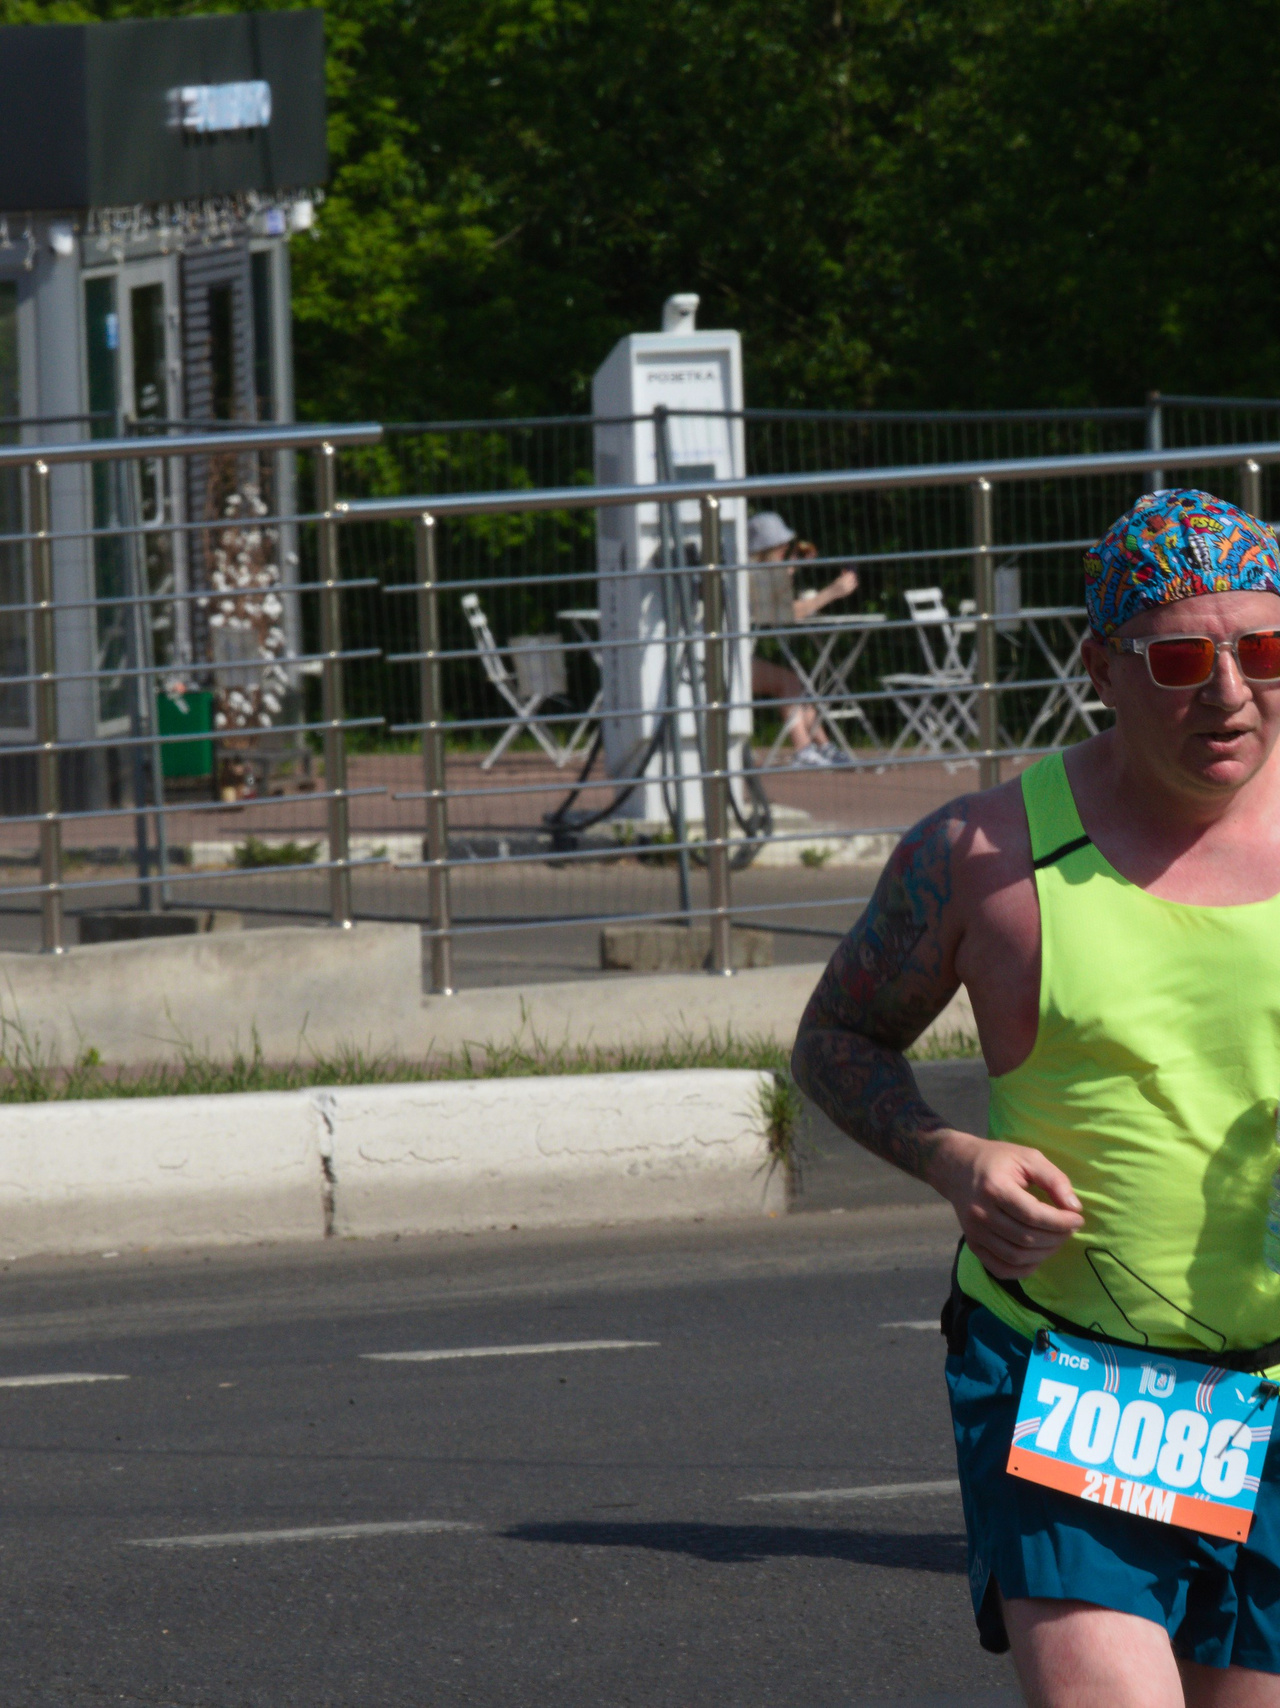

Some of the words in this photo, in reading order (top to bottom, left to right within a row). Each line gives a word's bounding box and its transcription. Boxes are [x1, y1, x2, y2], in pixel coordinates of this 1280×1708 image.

[648, 371, 714, 383] РОЗЕТКА
[1058, 1353, 1090, 1371] ПСБ
[1035, 1378, 1252, 1498] 70086
